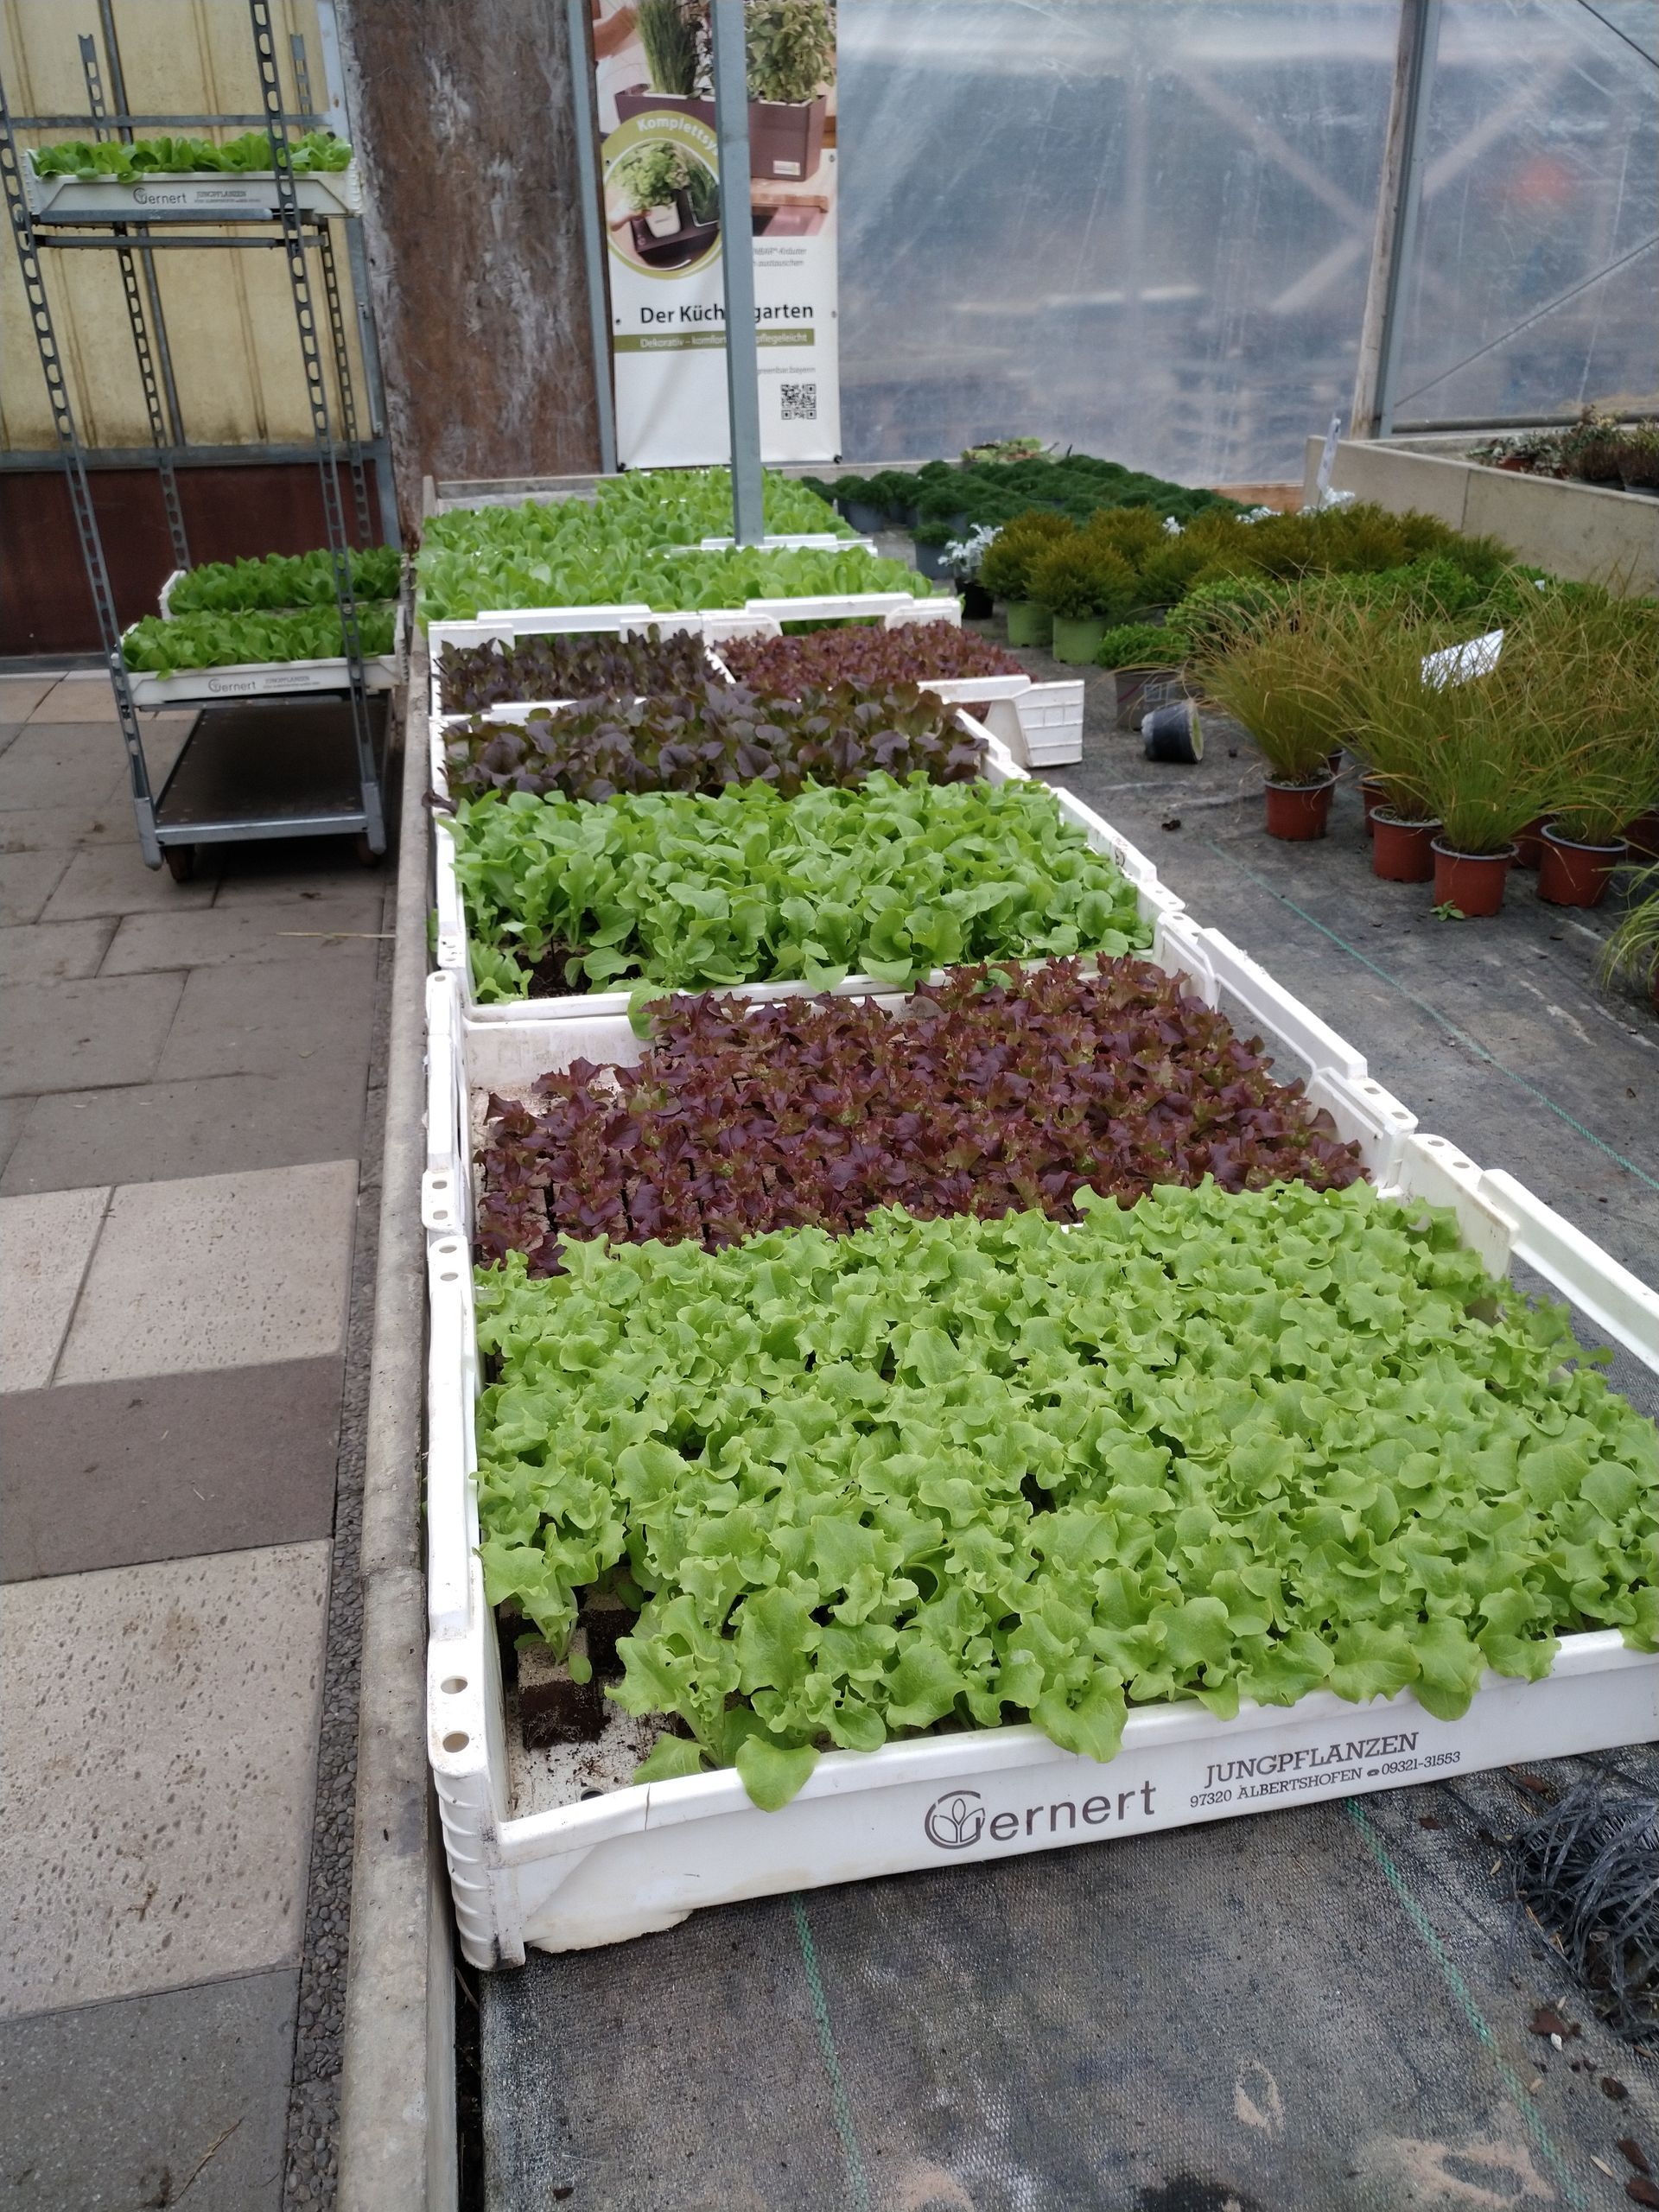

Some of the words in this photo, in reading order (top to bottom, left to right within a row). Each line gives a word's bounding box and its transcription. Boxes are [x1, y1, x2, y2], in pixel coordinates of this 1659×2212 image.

[133, 187, 188, 205] Gernert
[640, 307, 675, 324] Der
[680, 302, 814, 323] Küchgarten
[208, 677, 257, 693] Gernert
[1189, 1789, 1233, 1808] 97320
[1236, 1767, 1363, 1800] ALBERTSHOFEN
[1381, 1751, 1461, 1776] 09321-31553
[1203, 1732, 1420, 1789] JUNGPFLANZEN
[924, 1780, 1157, 1850] Gernert
